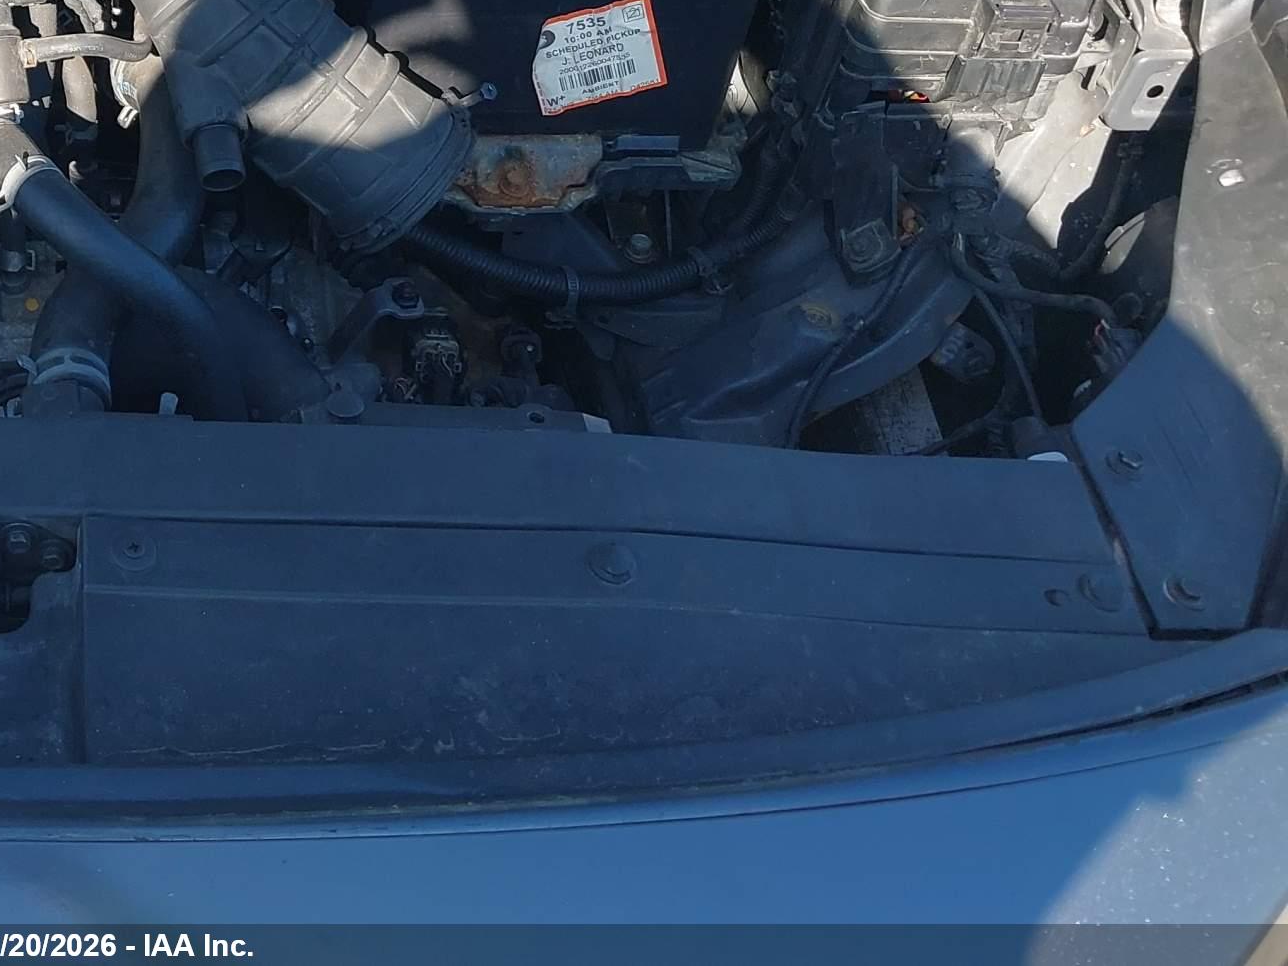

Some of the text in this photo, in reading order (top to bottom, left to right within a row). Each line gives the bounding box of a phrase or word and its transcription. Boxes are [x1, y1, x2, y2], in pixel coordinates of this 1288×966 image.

[566, 16, 606, 34] 7535
[546, 28, 641, 59] SCHEDULED PICKUP
[564, 26, 613, 44] 10:00 AM
[572, 43, 625, 65] LEONARD
[582, 80, 619, 95] AMBIENT
[546, 94, 566, 107] W+
